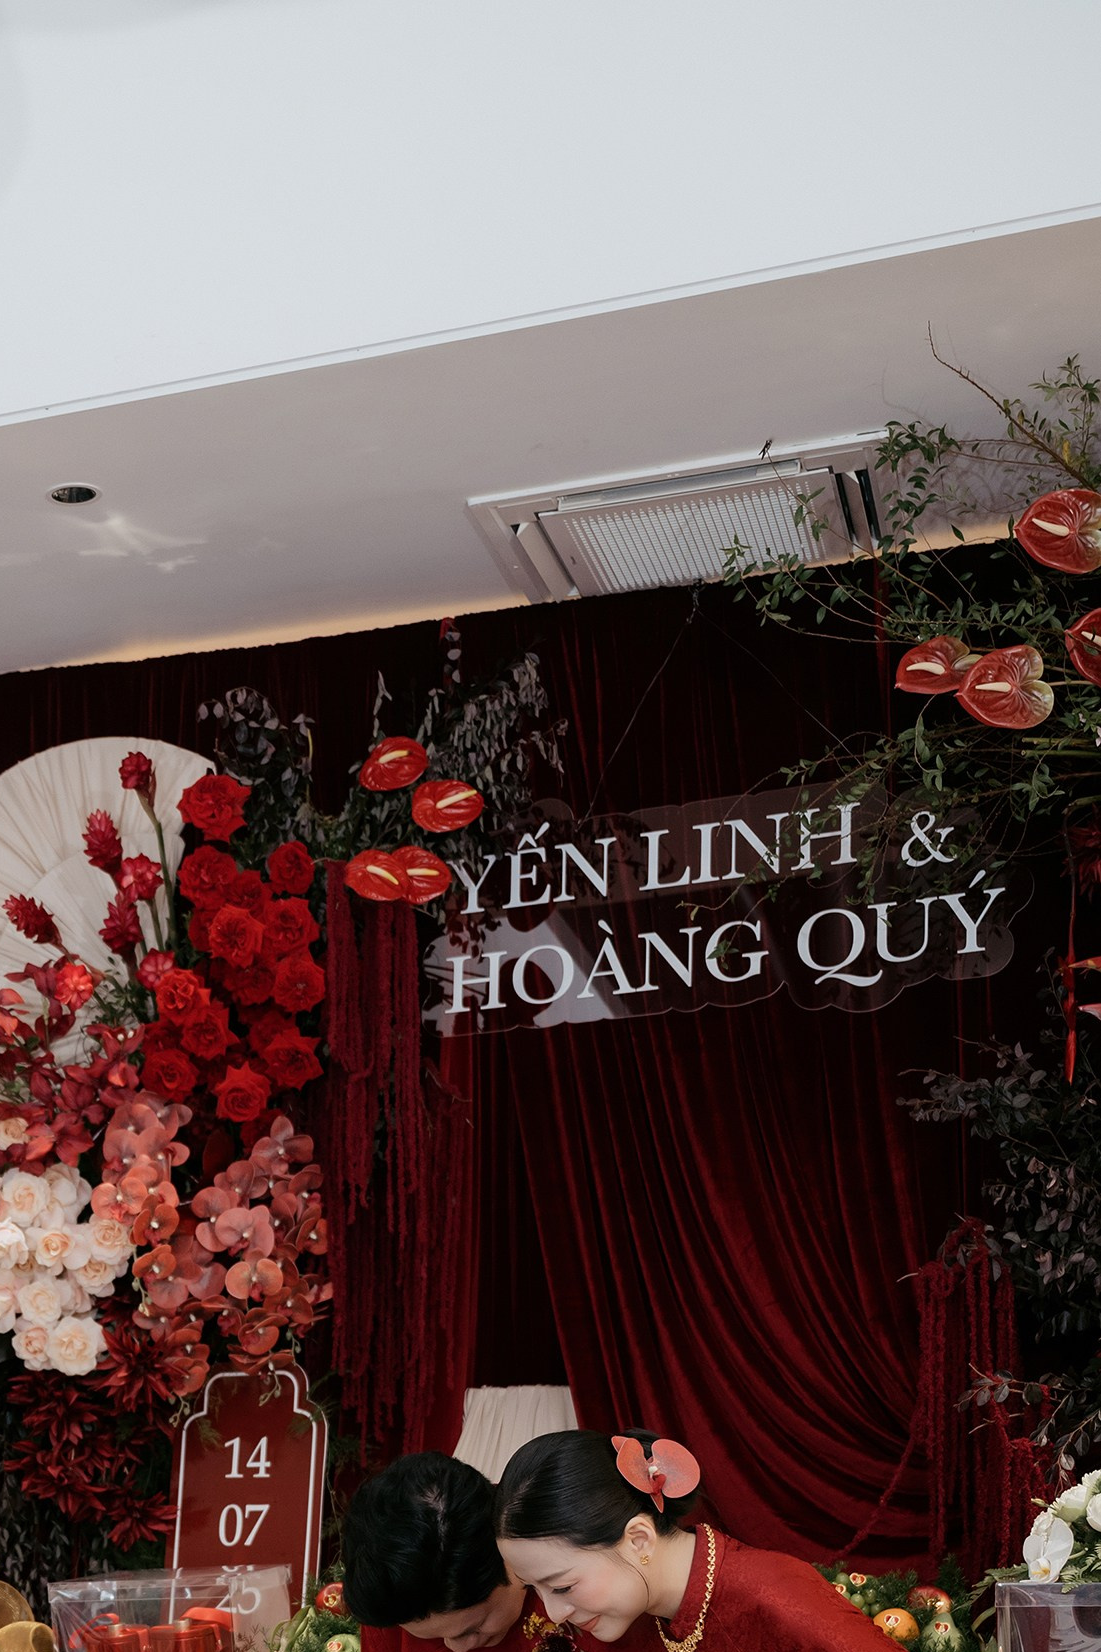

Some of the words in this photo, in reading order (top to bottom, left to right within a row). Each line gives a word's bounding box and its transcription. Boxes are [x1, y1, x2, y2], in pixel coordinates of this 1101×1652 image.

[446, 821, 617, 915] YẾN
[638, 801, 861, 892] LINH
[900, 810, 958, 868] &
[444, 918, 770, 1014] HOÀNG
[796, 869, 1006, 988] QUÝ
[224, 1435, 272, 1479] 14
[217, 1503, 271, 1547] 07
[215, 1571, 262, 1615] 25
